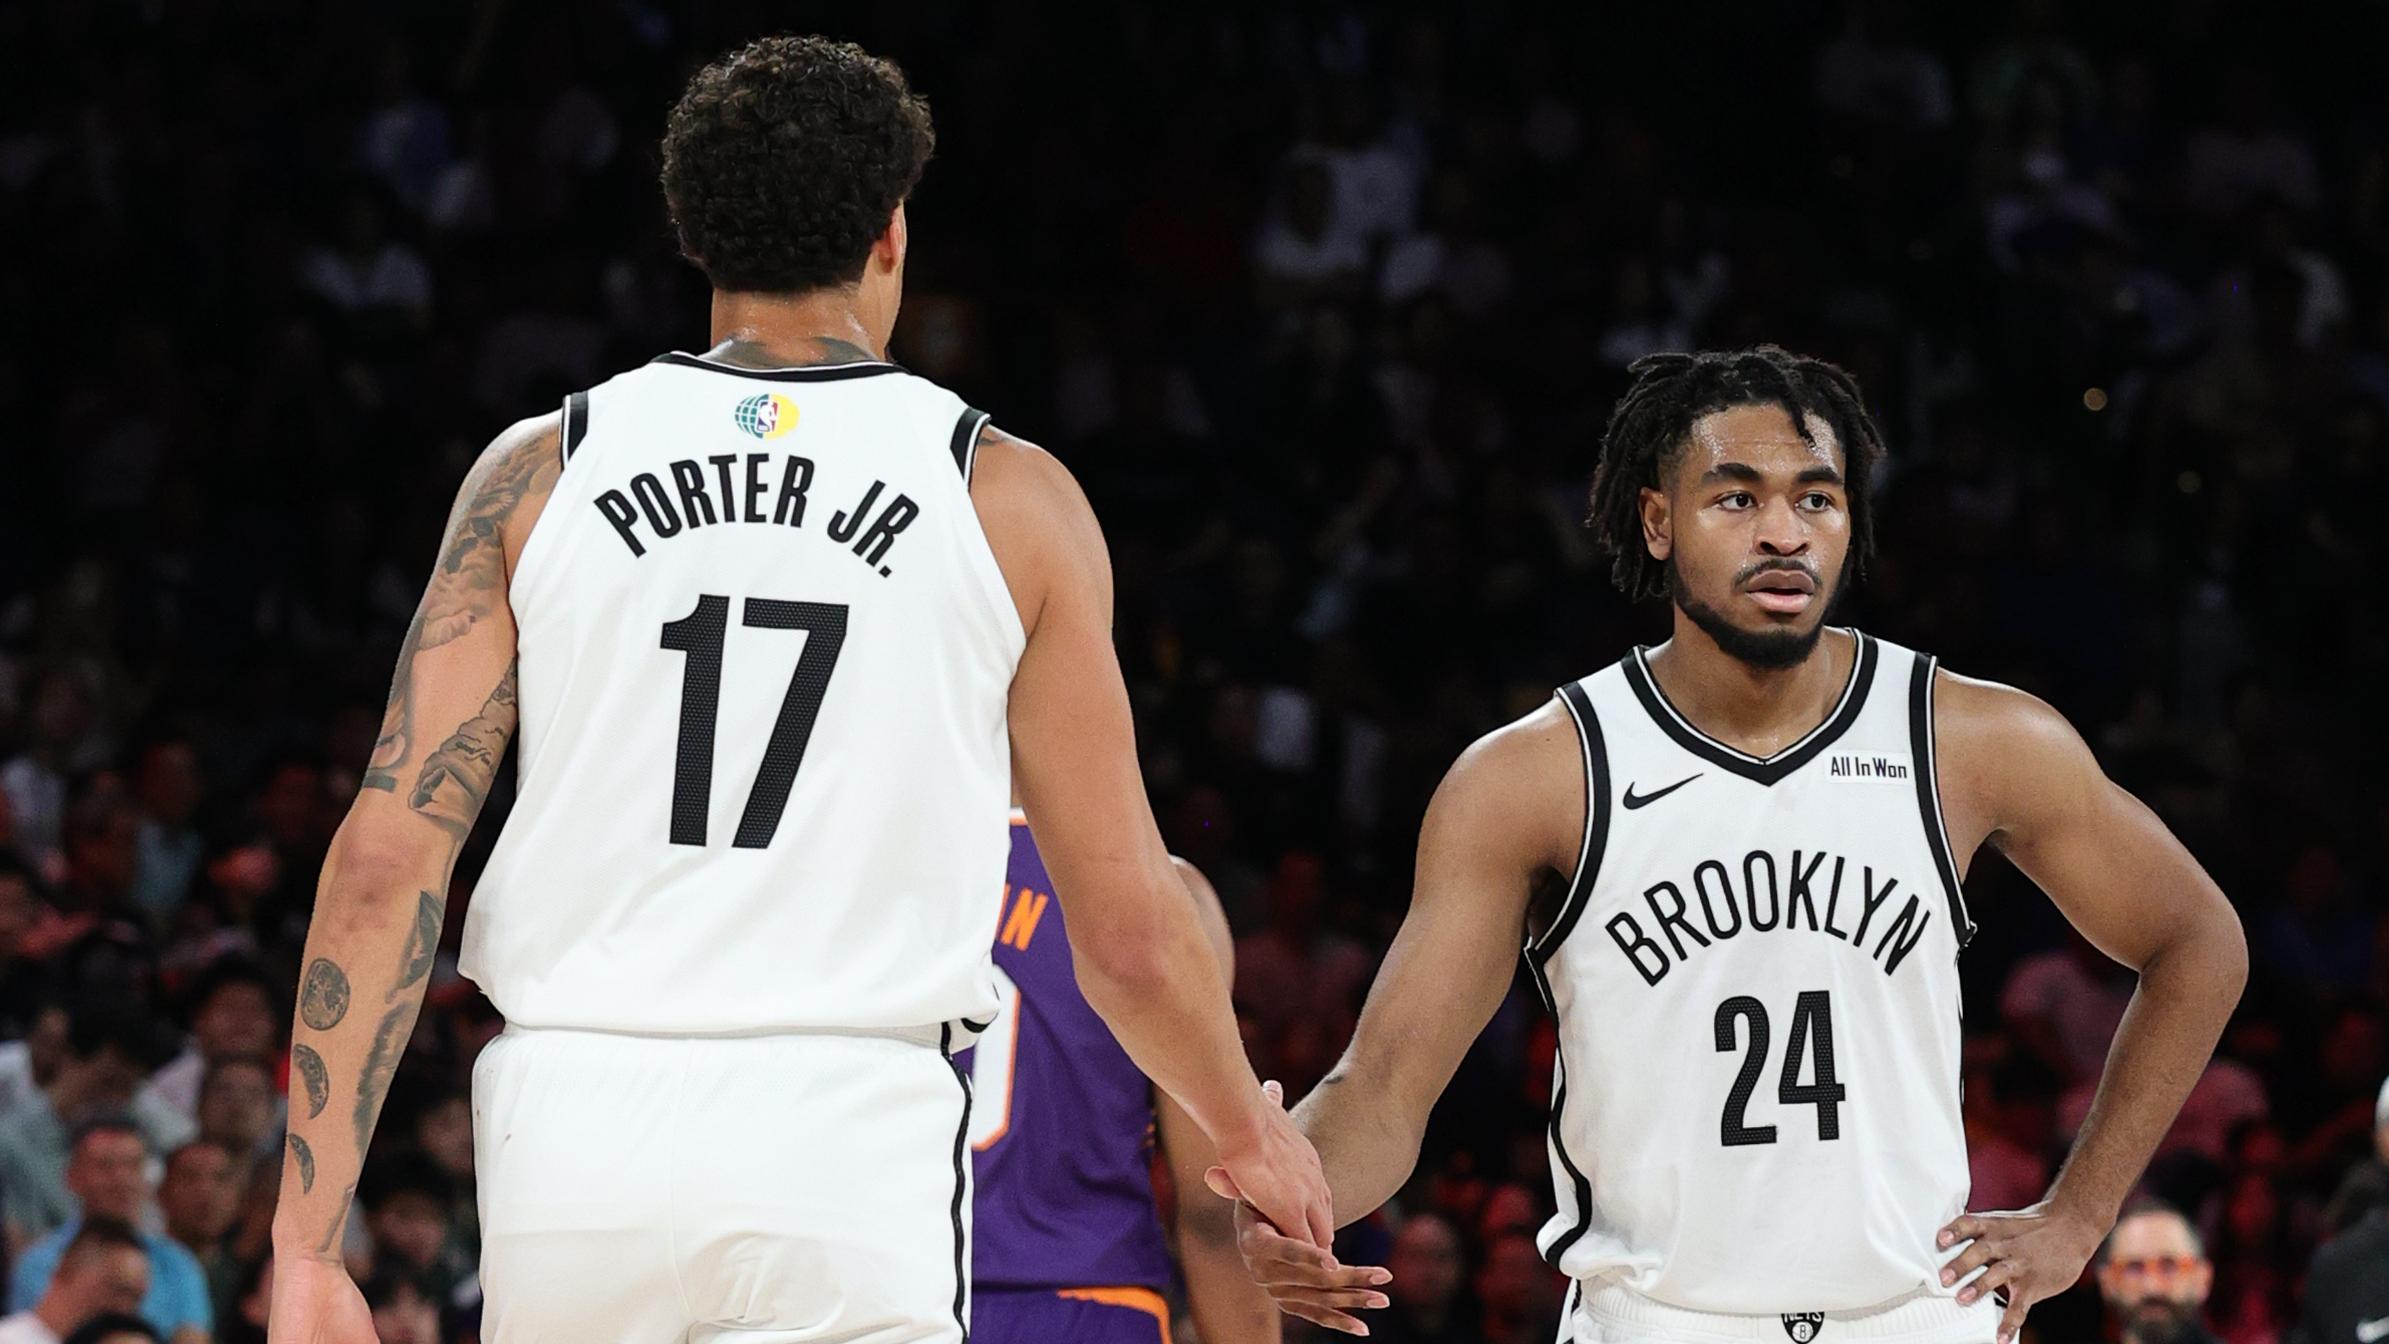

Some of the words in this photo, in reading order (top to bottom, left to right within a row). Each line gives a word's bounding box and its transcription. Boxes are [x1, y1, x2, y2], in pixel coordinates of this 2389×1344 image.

[593, 452, 815, 559] PORTER
[826, 479, 920, 579] JR.
[659, 593, 850, 850] 17
[1831, 756, 1851, 776] All
[1855, 756, 1871, 776] In
[1872, 757, 1908, 779] Won
[1604, 849, 1931, 988] BROOKLYN
[1713, 989, 1846, 1147] 24
